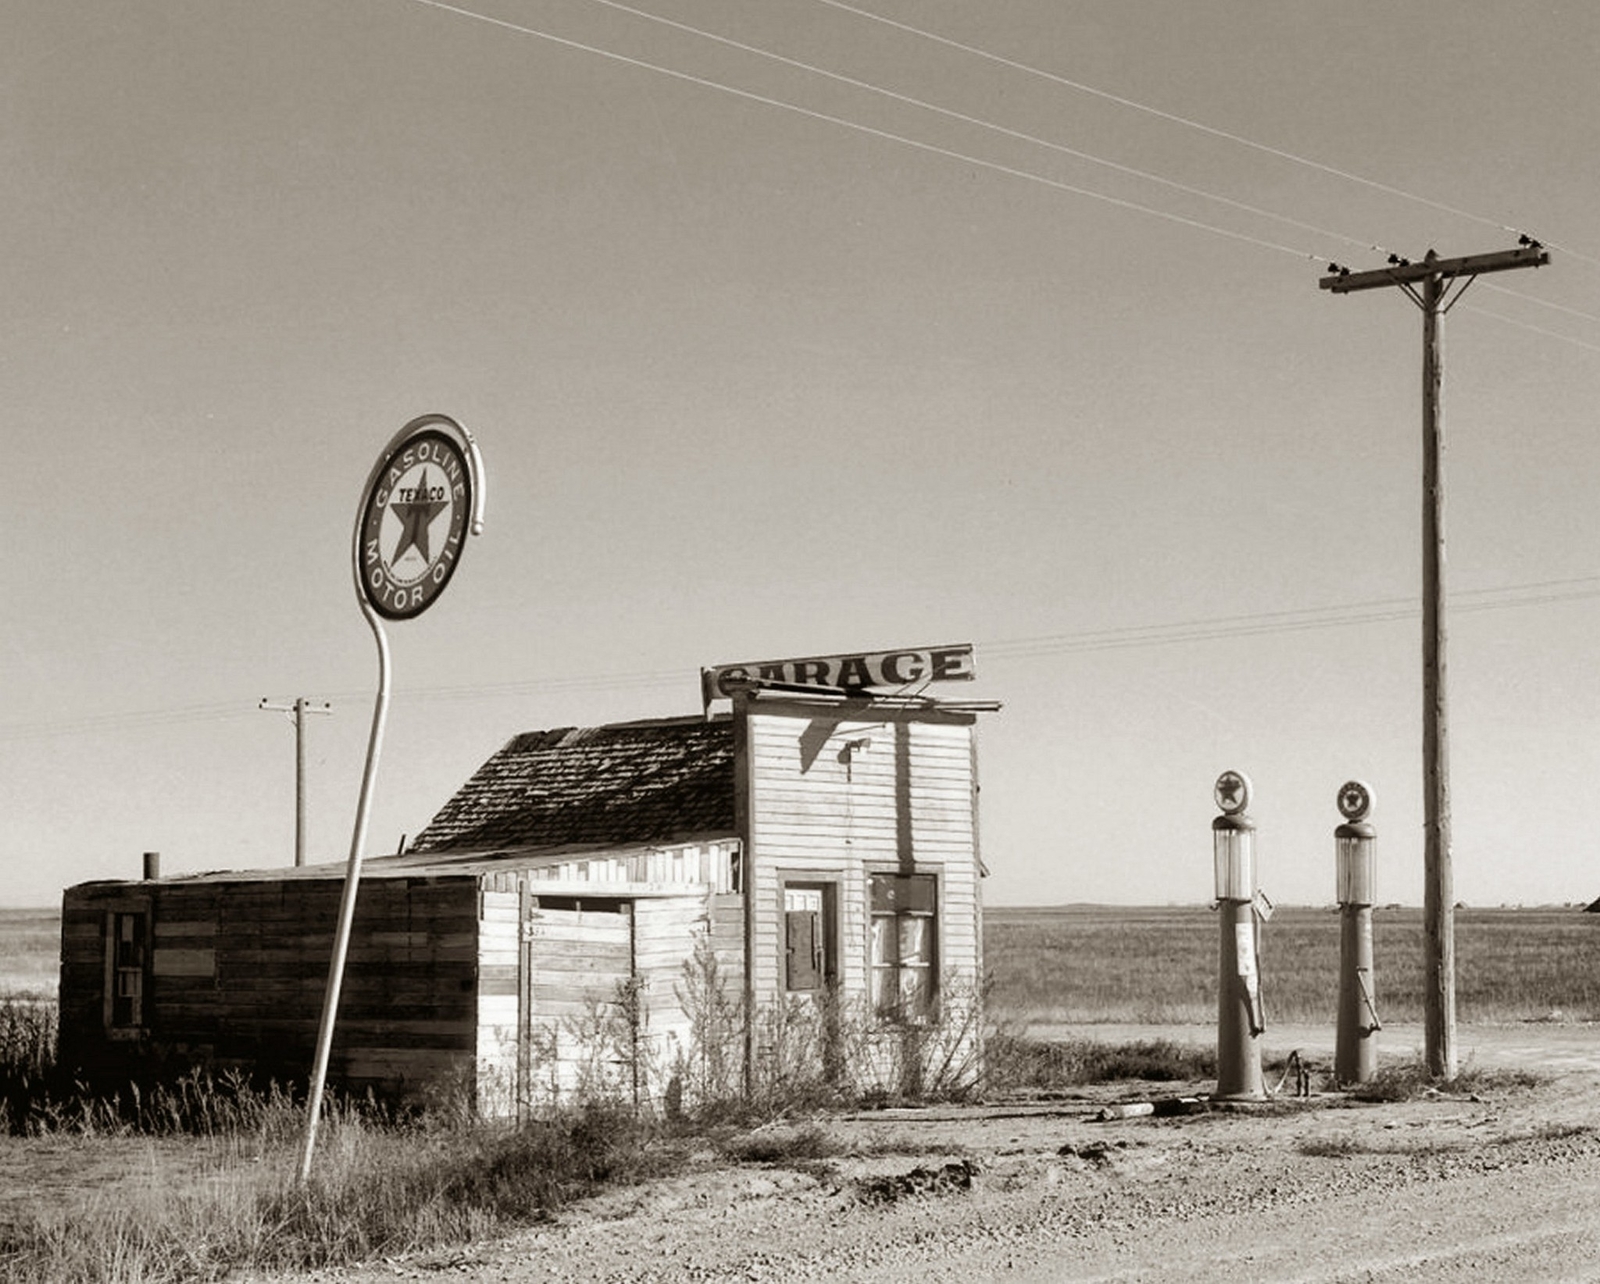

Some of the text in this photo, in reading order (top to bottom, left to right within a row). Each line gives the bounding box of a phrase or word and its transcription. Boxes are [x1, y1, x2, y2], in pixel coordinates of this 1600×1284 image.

[376, 443, 464, 508] GASOLINE
[399, 486, 445, 502] TEXACO
[367, 538, 424, 609] MOTOR
[432, 530, 460, 584] OIL
[717, 650, 973, 697] GARAGE
